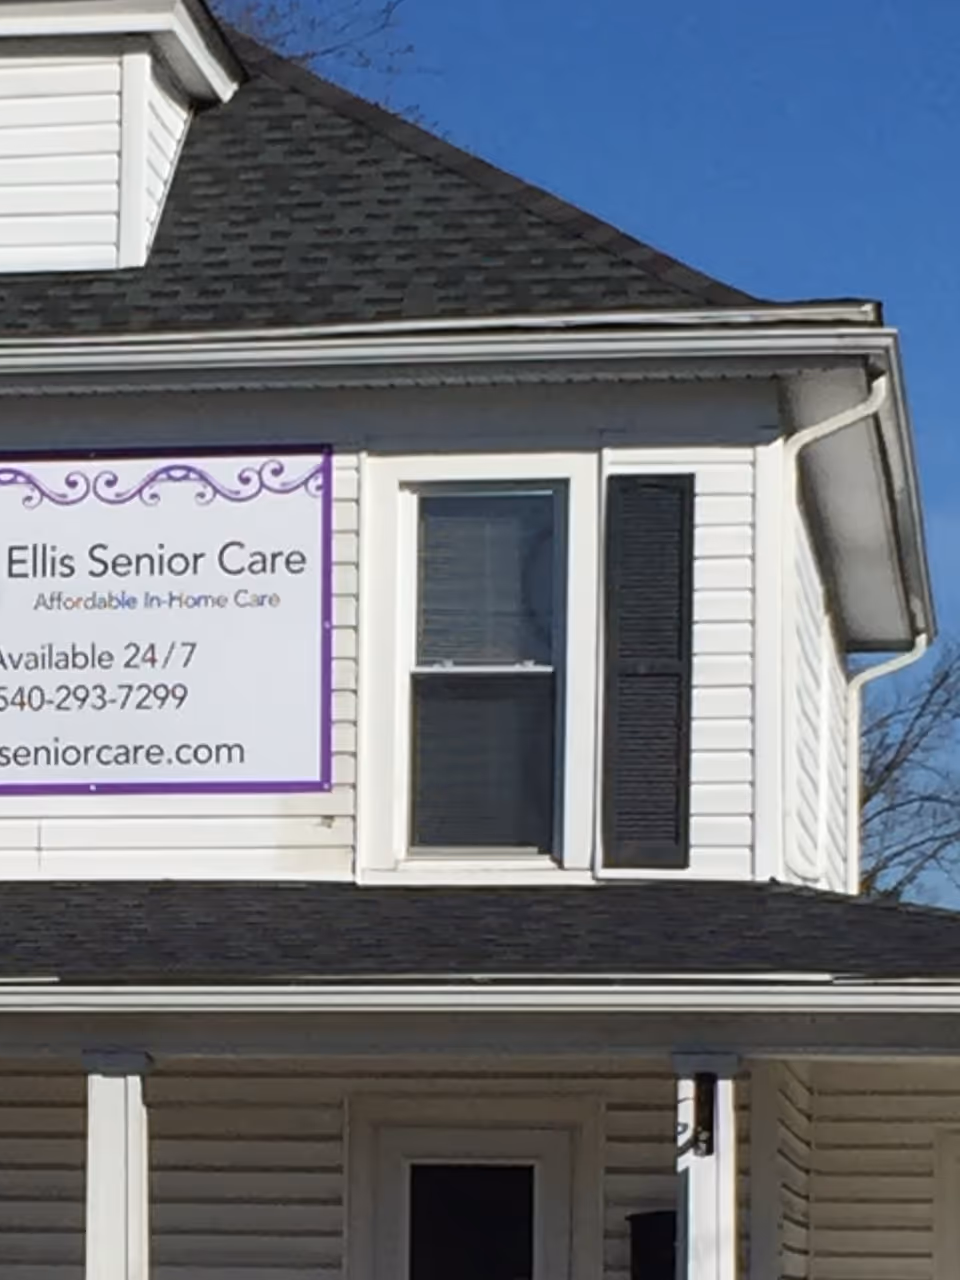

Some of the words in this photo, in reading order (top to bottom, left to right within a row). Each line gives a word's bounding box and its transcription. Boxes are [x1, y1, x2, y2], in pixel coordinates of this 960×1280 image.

[7, 543, 75, 578] Ellis
[88, 543, 206, 578] Senior
[218, 541, 307, 576] Care
[33, 590, 138, 610] Affordable
[144, 590, 228, 609] In-Home
[234, 589, 280, 608] Care
[123, 641, 197, 669] 24/7
